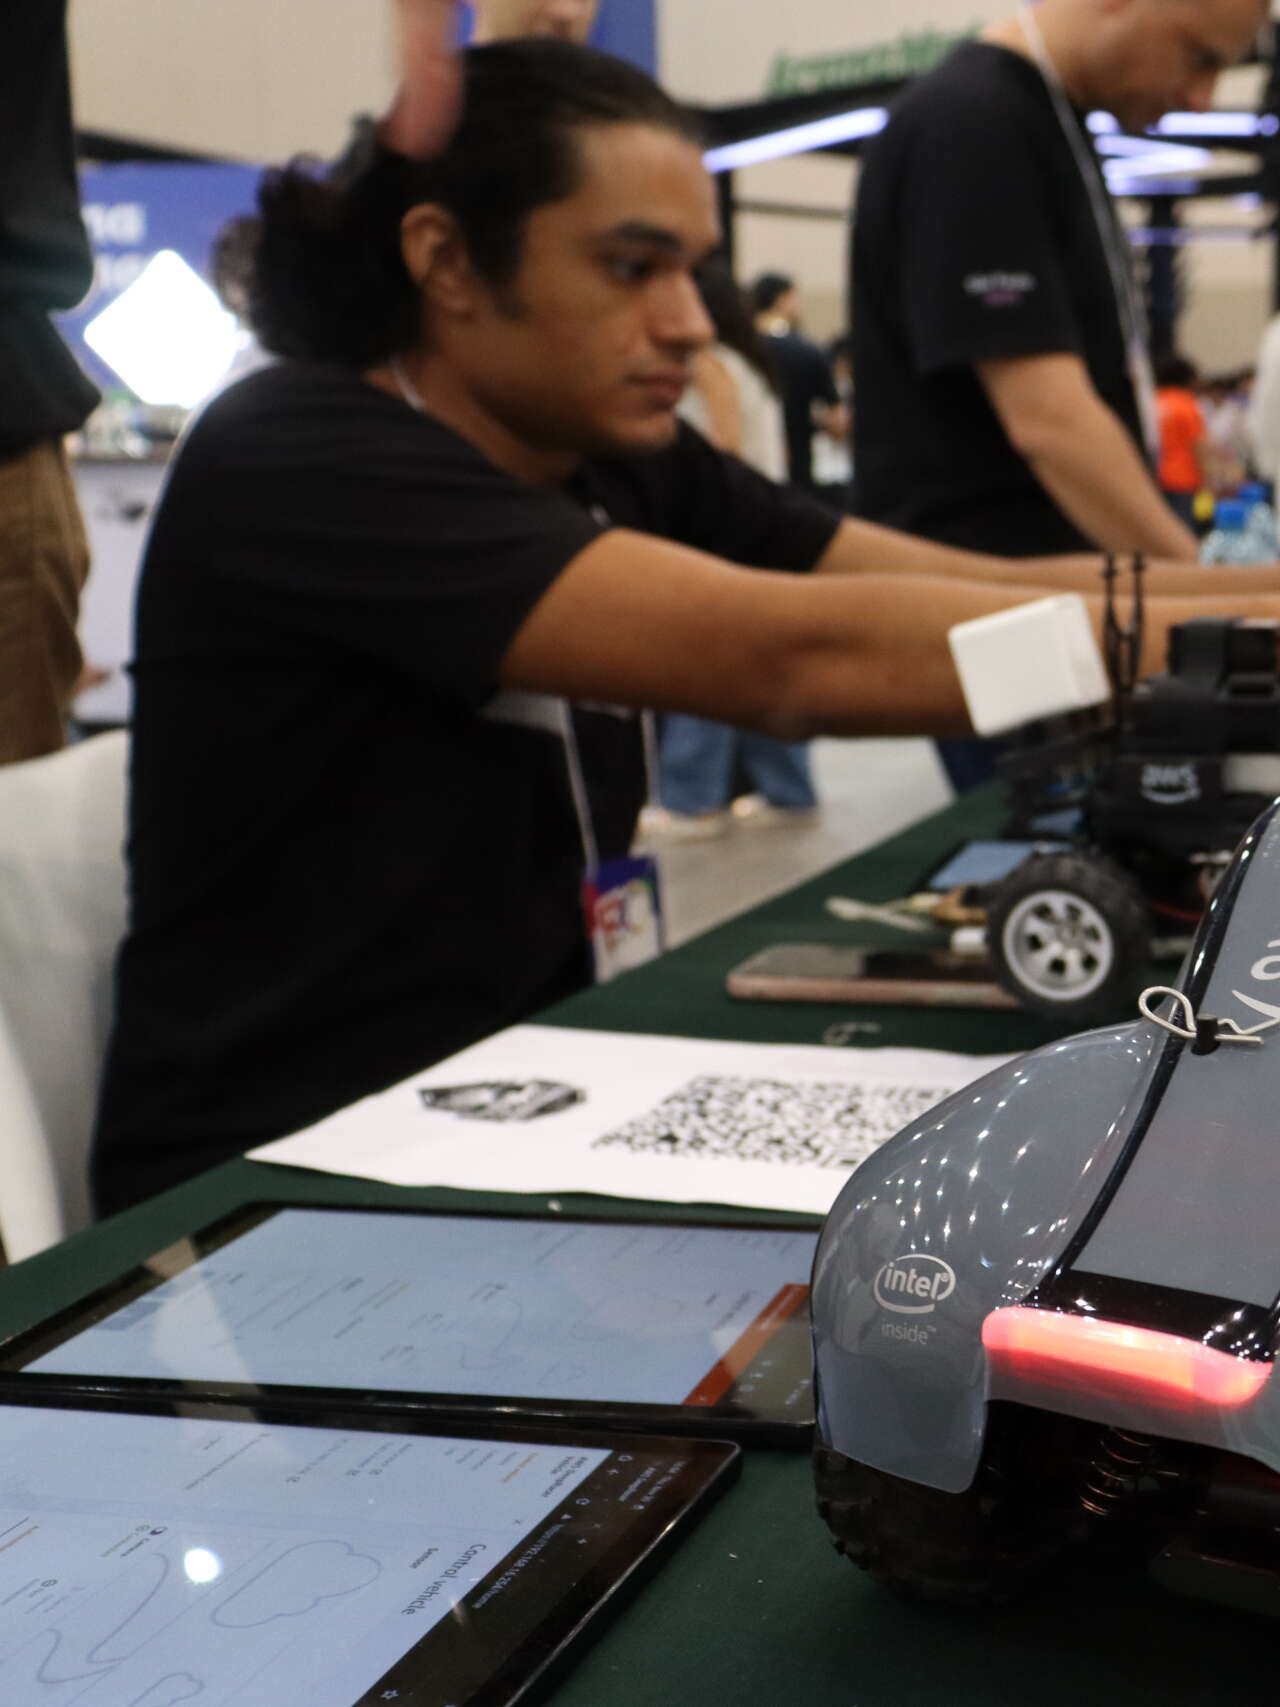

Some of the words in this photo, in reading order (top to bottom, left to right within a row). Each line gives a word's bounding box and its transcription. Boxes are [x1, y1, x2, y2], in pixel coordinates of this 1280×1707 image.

[1141, 763, 1199, 789] aws
[440, 1543, 487, 1578] Control
[401, 1579, 445, 1615] vehicle
